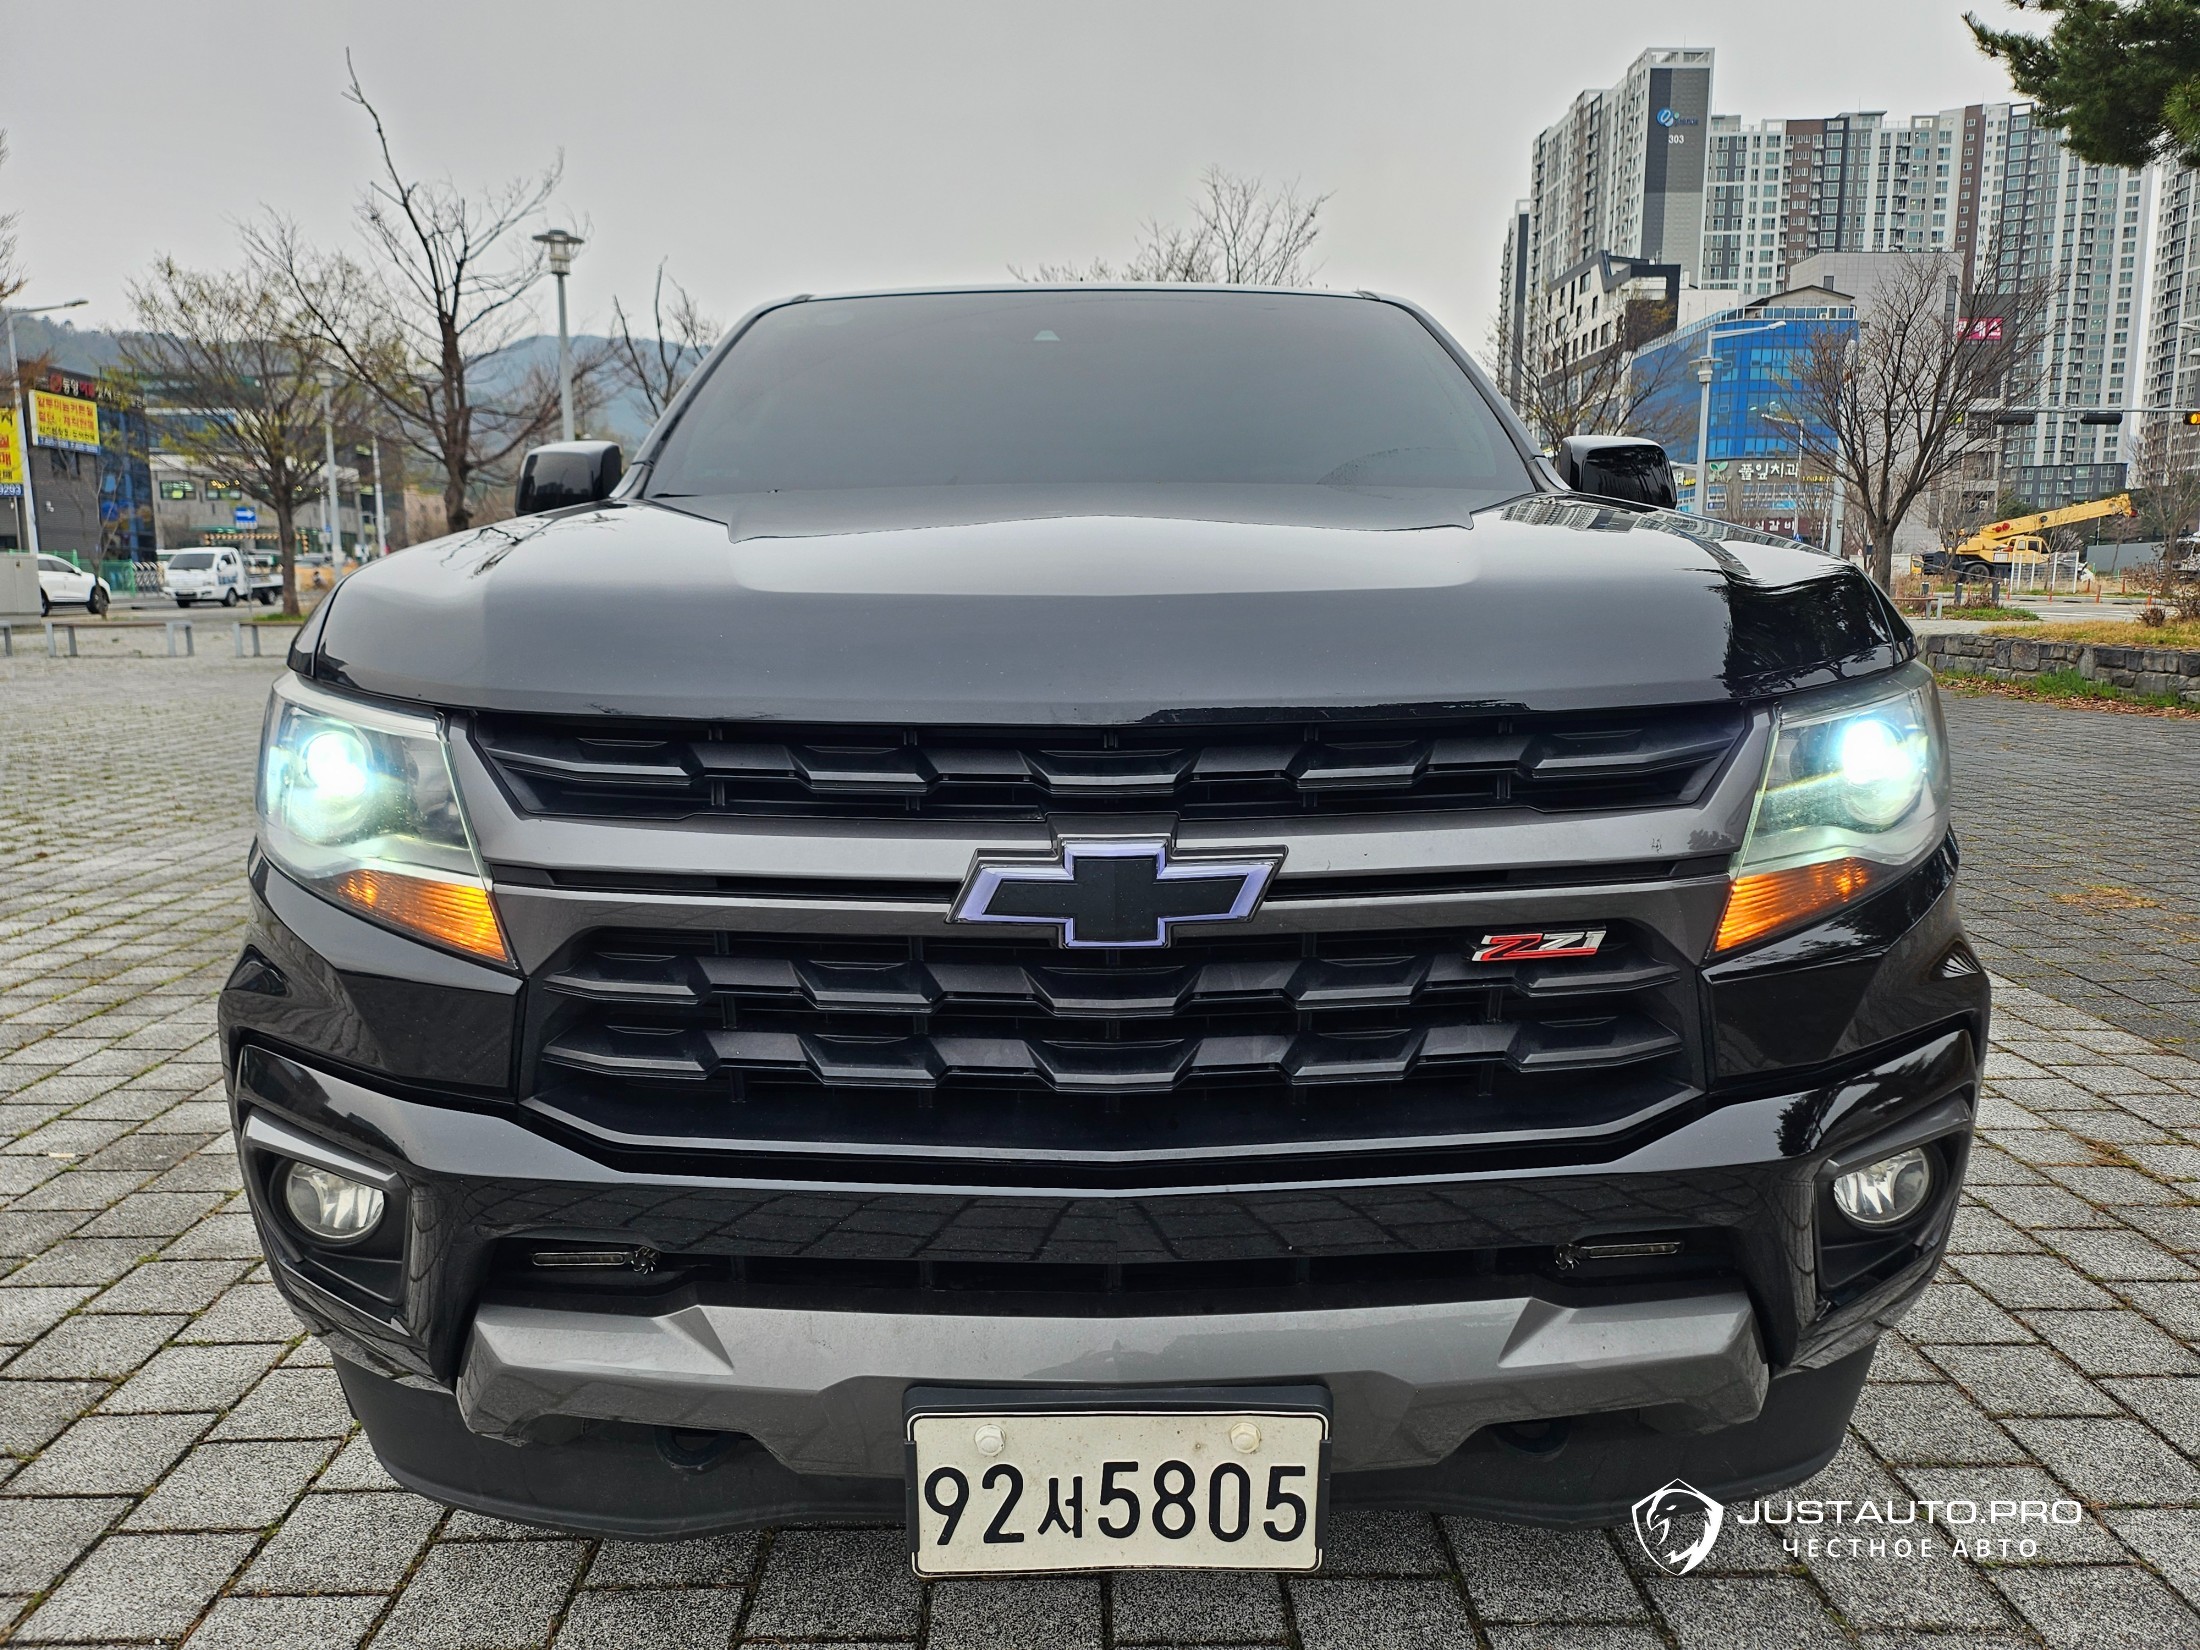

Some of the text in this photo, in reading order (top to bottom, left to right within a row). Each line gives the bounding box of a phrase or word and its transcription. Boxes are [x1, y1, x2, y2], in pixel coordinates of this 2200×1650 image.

[1668, 134, 1685, 144] 303
[1738, 462, 1799, 481] 풀잎치과
[1472, 930, 1607, 961] Z71
[924, 1460, 1308, 1546] 92서5805
